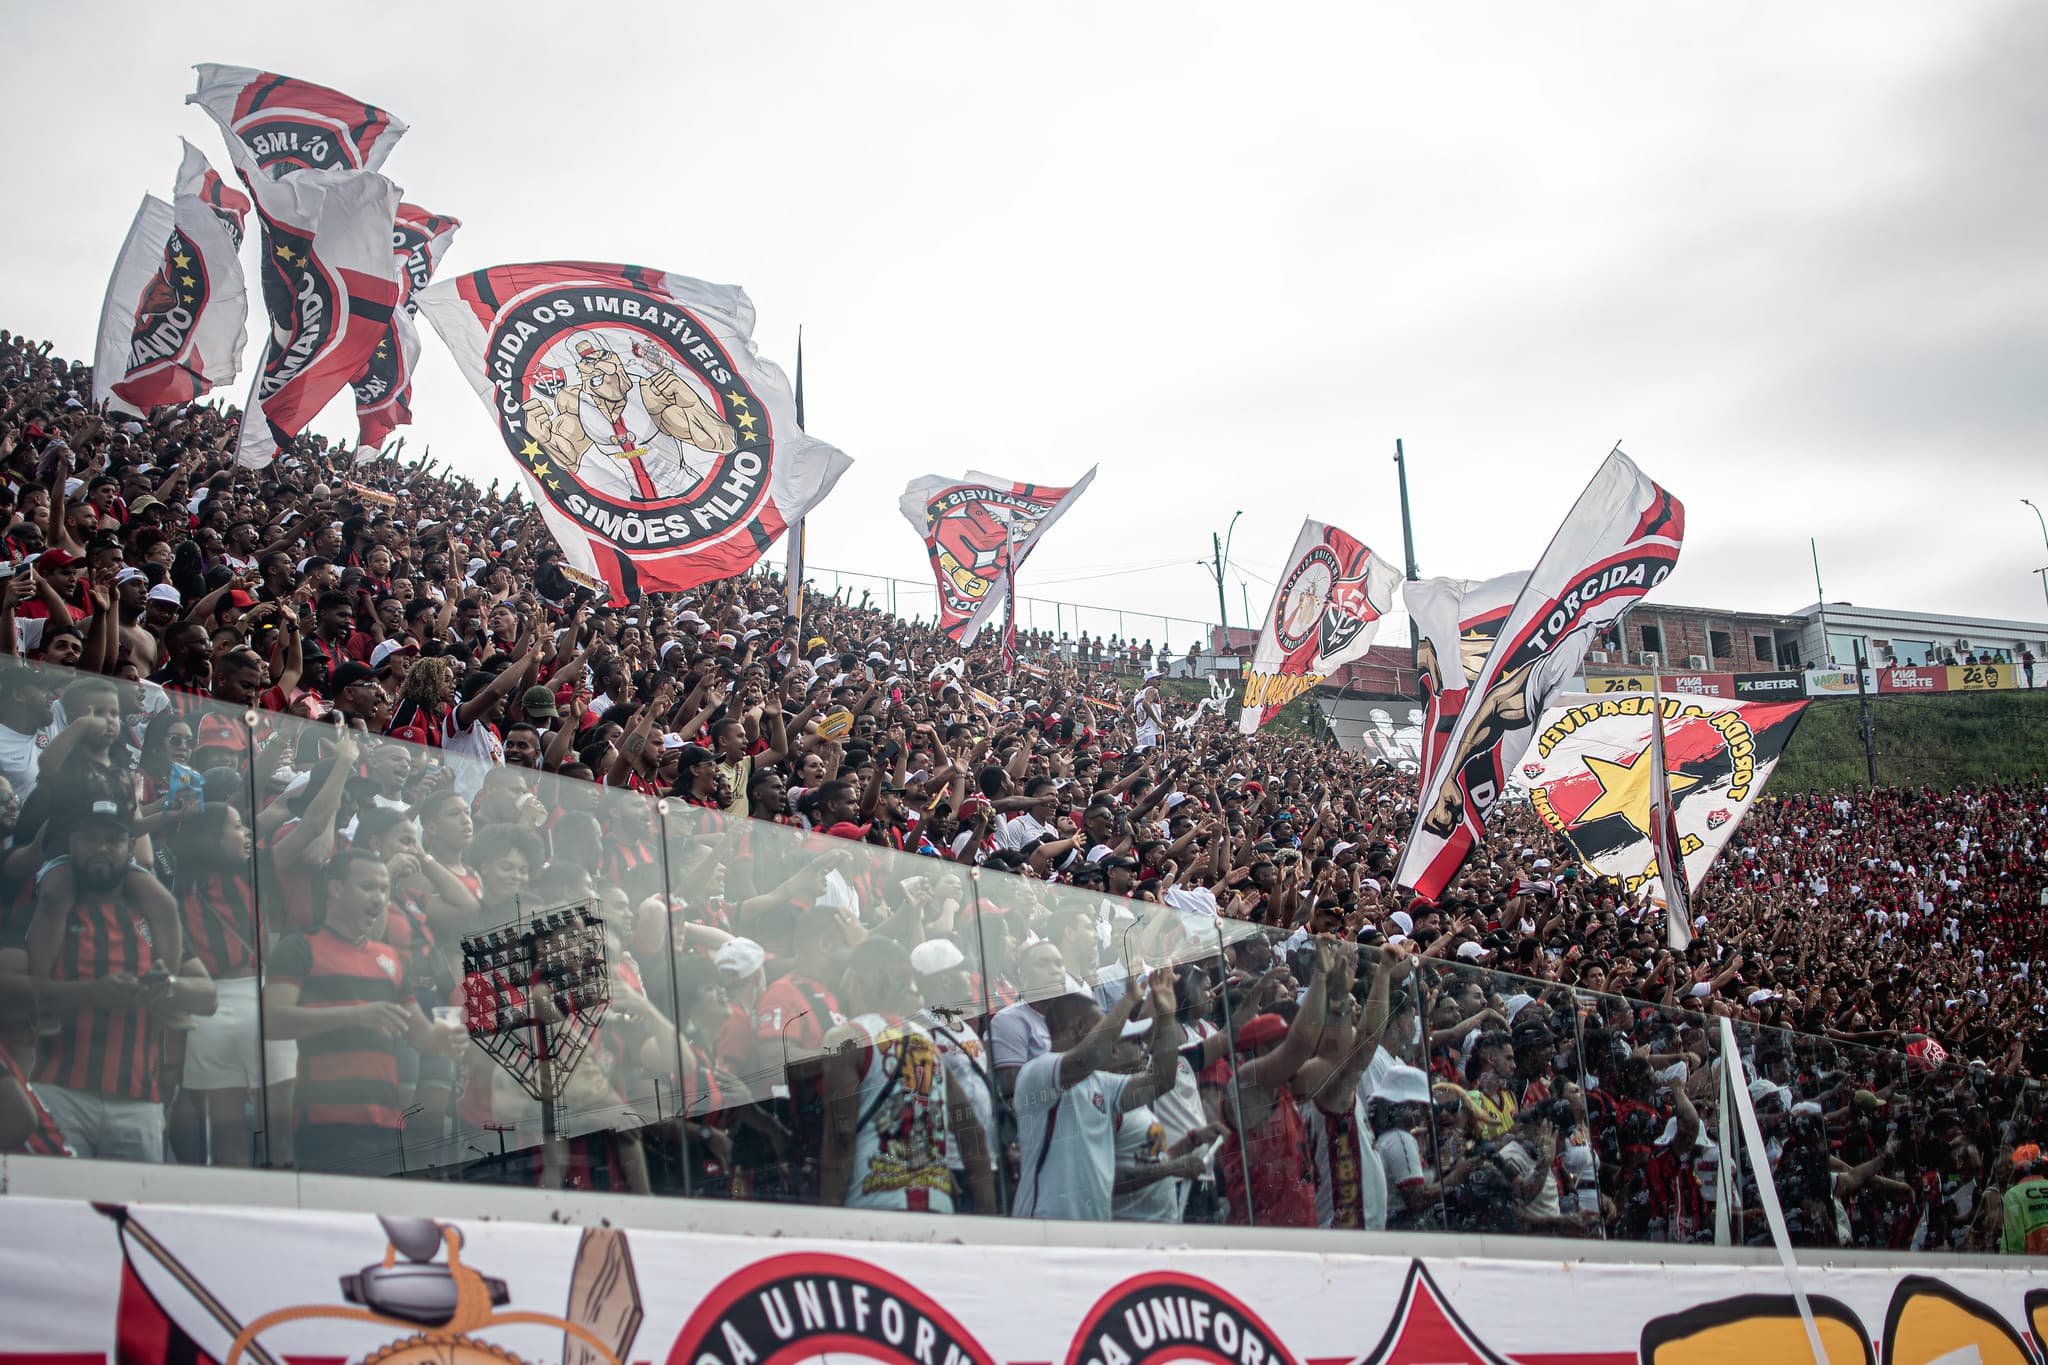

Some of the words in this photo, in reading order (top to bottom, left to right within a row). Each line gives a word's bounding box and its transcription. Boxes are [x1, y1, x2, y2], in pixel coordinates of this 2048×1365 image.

[497, 320, 539, 434] TORCIDA
[532, 298, 576, 325] OS
[583, 295, 732, 385] IMBATÍVEIS
[563, 493, 691, 545] SIMÕES
[690, 450, 762, 531] FILHO
[1527, 563, 1645, 651] TORCIDA
[1675, 677, 1702, 686] VIVA
[1843, 673, 1870, 686] BLE
[1891, 669, 1917, 679] VIVA
[1963, 667, 1984, 684] Zé
[1892, 678, 1934, 688] SORTE
